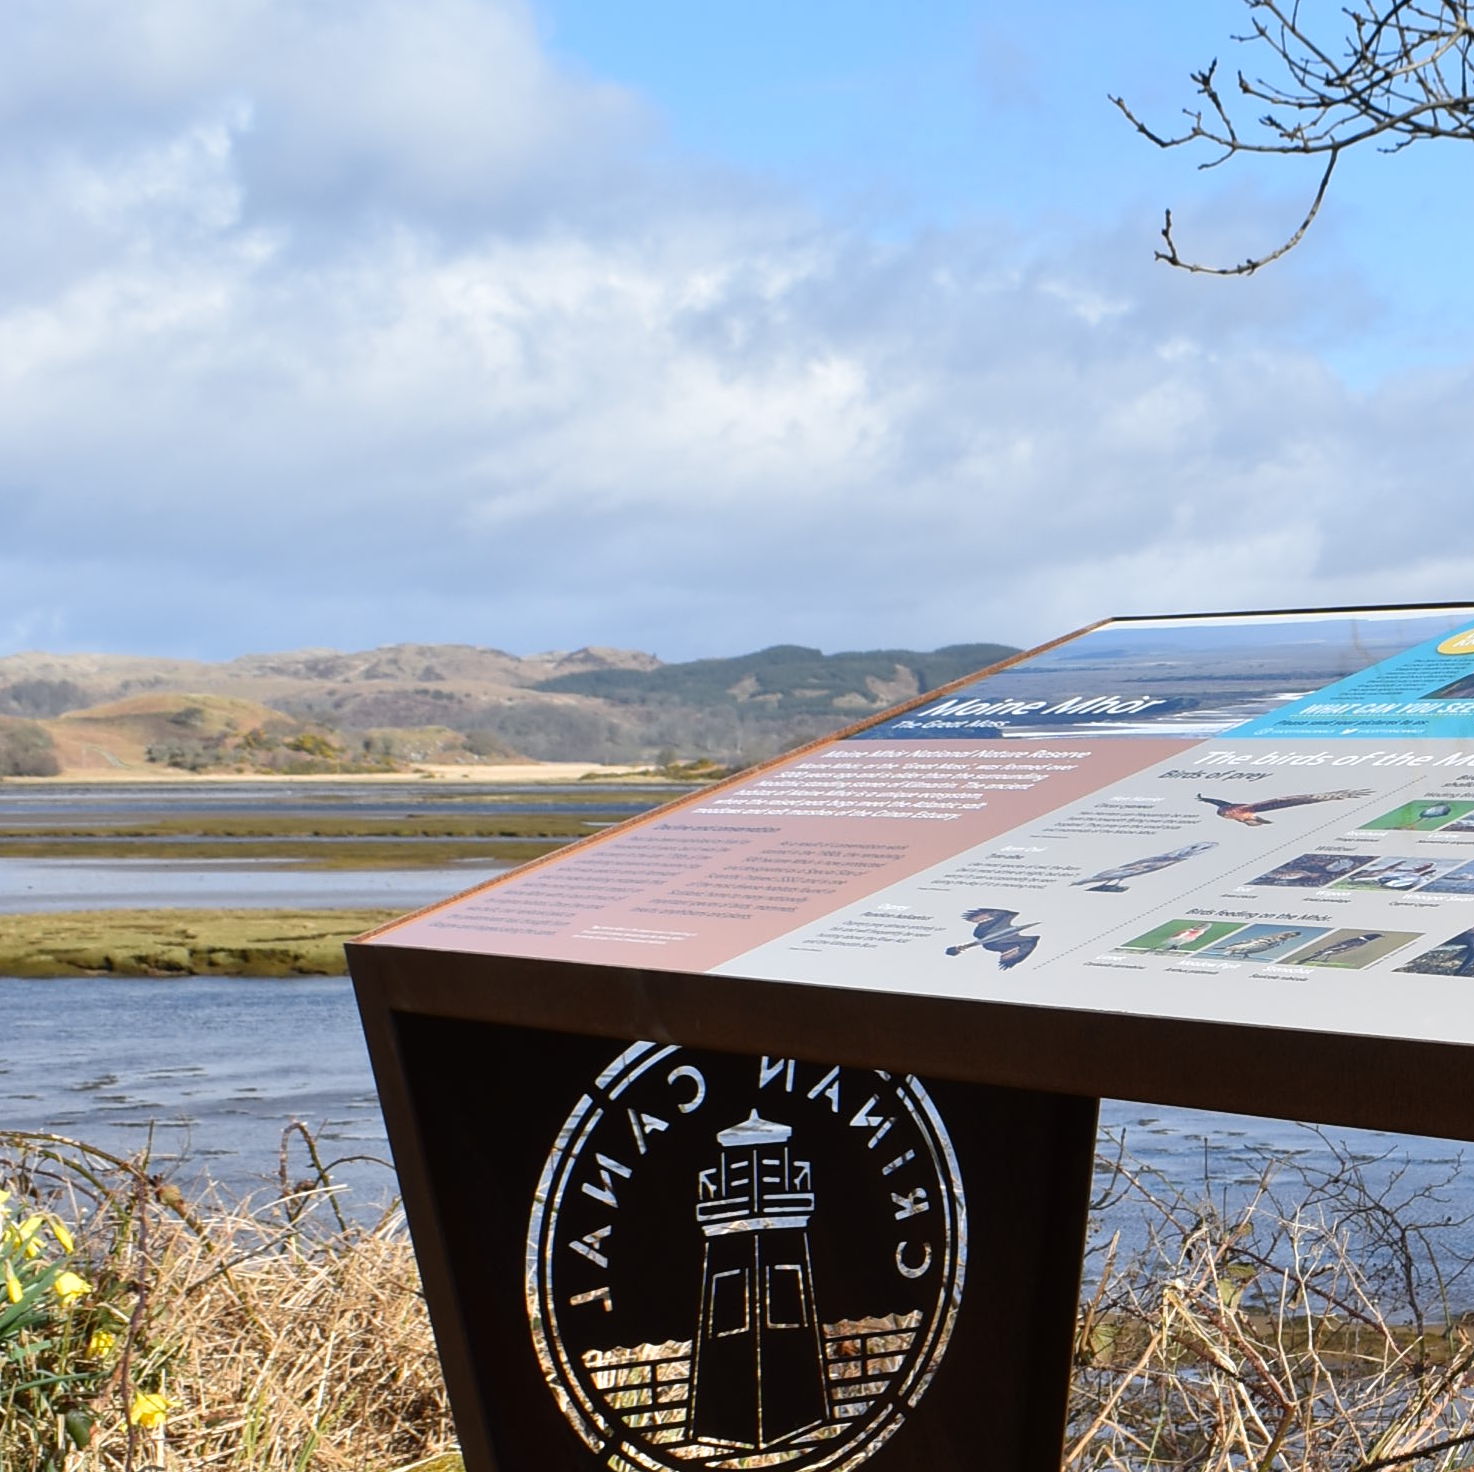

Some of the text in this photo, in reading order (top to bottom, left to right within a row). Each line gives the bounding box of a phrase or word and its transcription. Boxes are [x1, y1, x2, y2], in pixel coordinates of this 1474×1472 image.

[918, 696, 1166, 716] Moine Mhòr
[1300, 704, 1361, 714] WHAT
[1353, 704, 1402, 714] CAN
[1396, 703, 1444, 713] YOU
[922, 720, 968, 728] Great
[965, 720, 1010, 728] Moss
[906, 750, 979, 758] National
[972, 750, 1029, 758] Nature
[1027, 750, 1091, 758] Reserve
[1194, 752, 1252, 764] The
[1250, 752, 1334, 765] birds
[1332, 752, 1384, 765] of
[1372, 752, 1434, 766] the
[1158, 770, 1272, 782] Birds of prey
[1215, 910, 1259, 919] feeding
